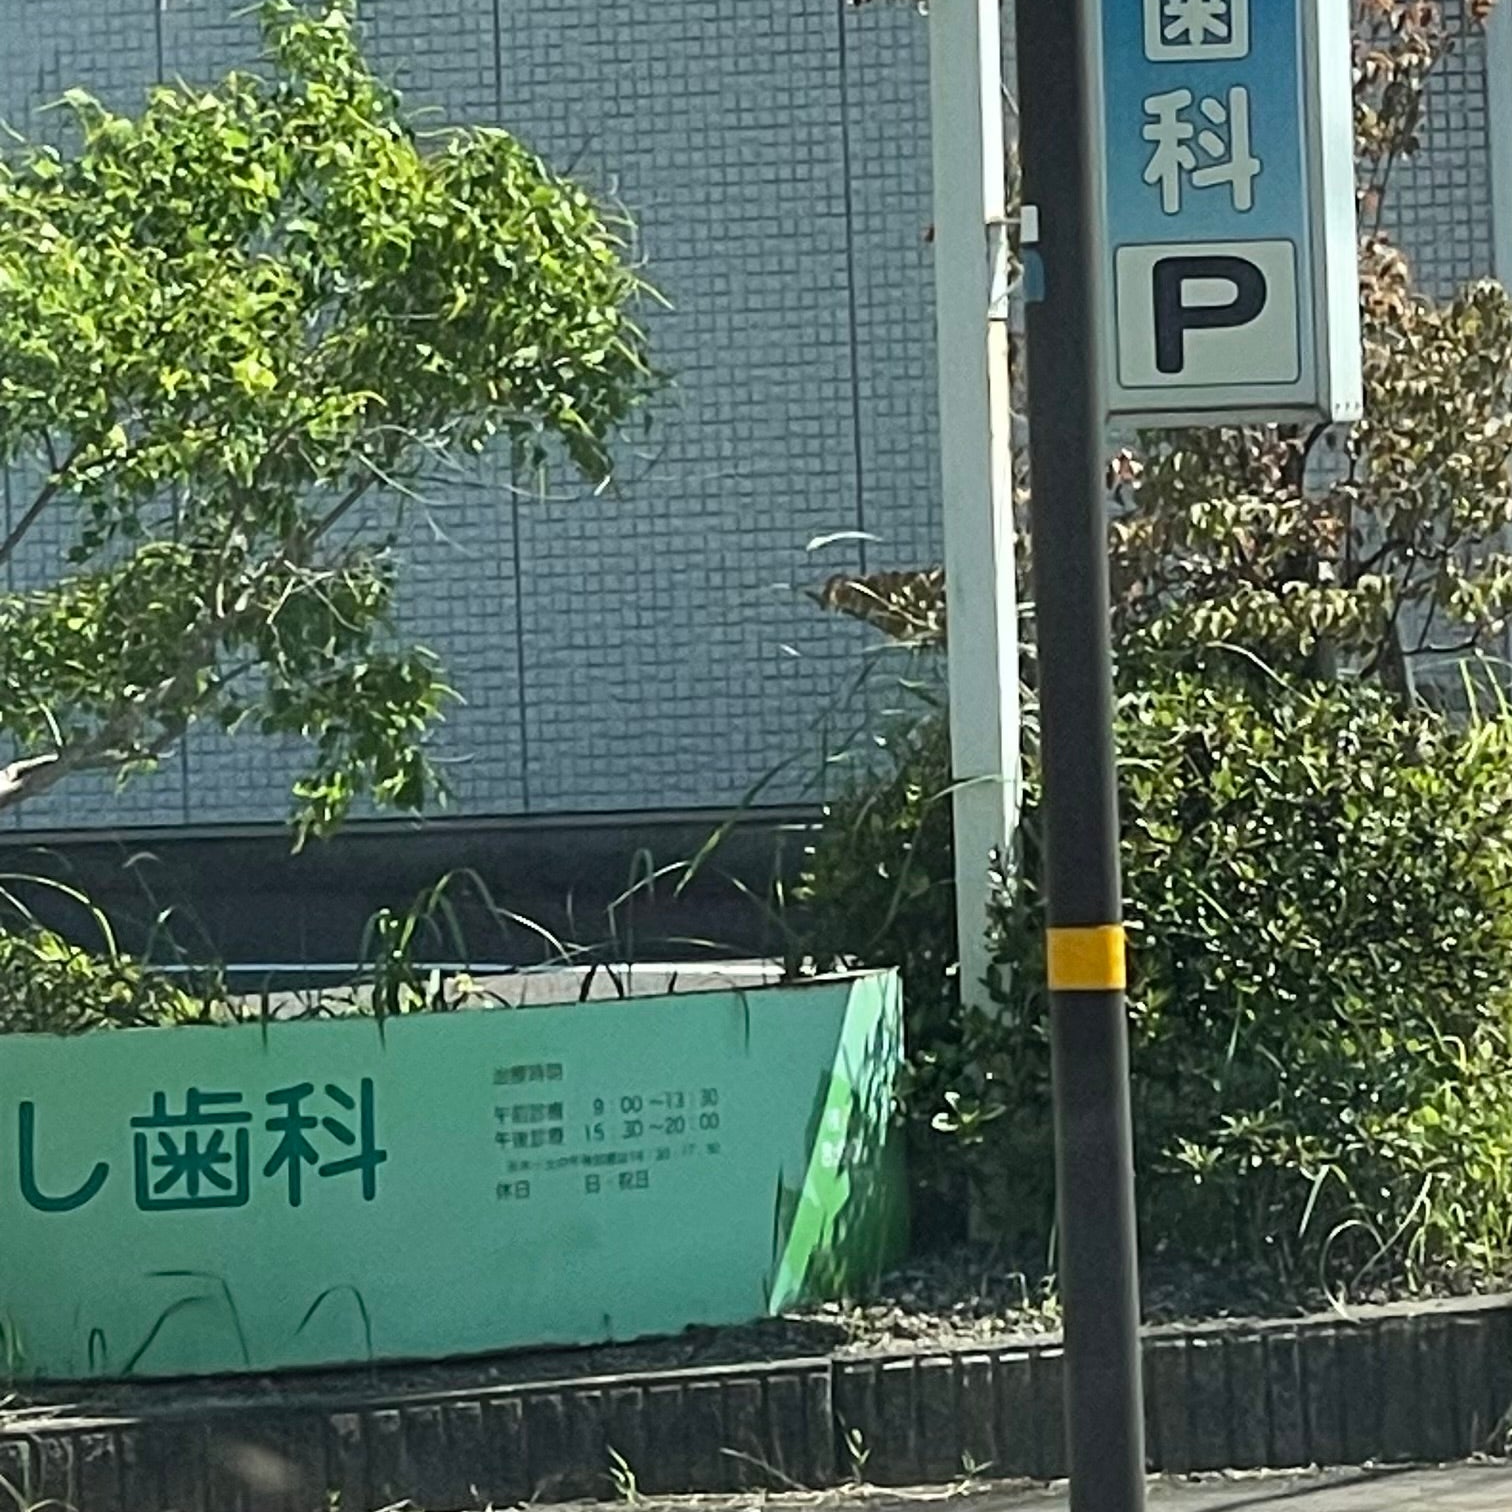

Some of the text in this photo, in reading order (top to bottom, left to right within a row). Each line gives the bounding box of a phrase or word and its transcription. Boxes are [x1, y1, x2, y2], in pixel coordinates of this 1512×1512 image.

[1151, 254, 1268, 375] P
[18, 1077, 388, 1212] し歯科
